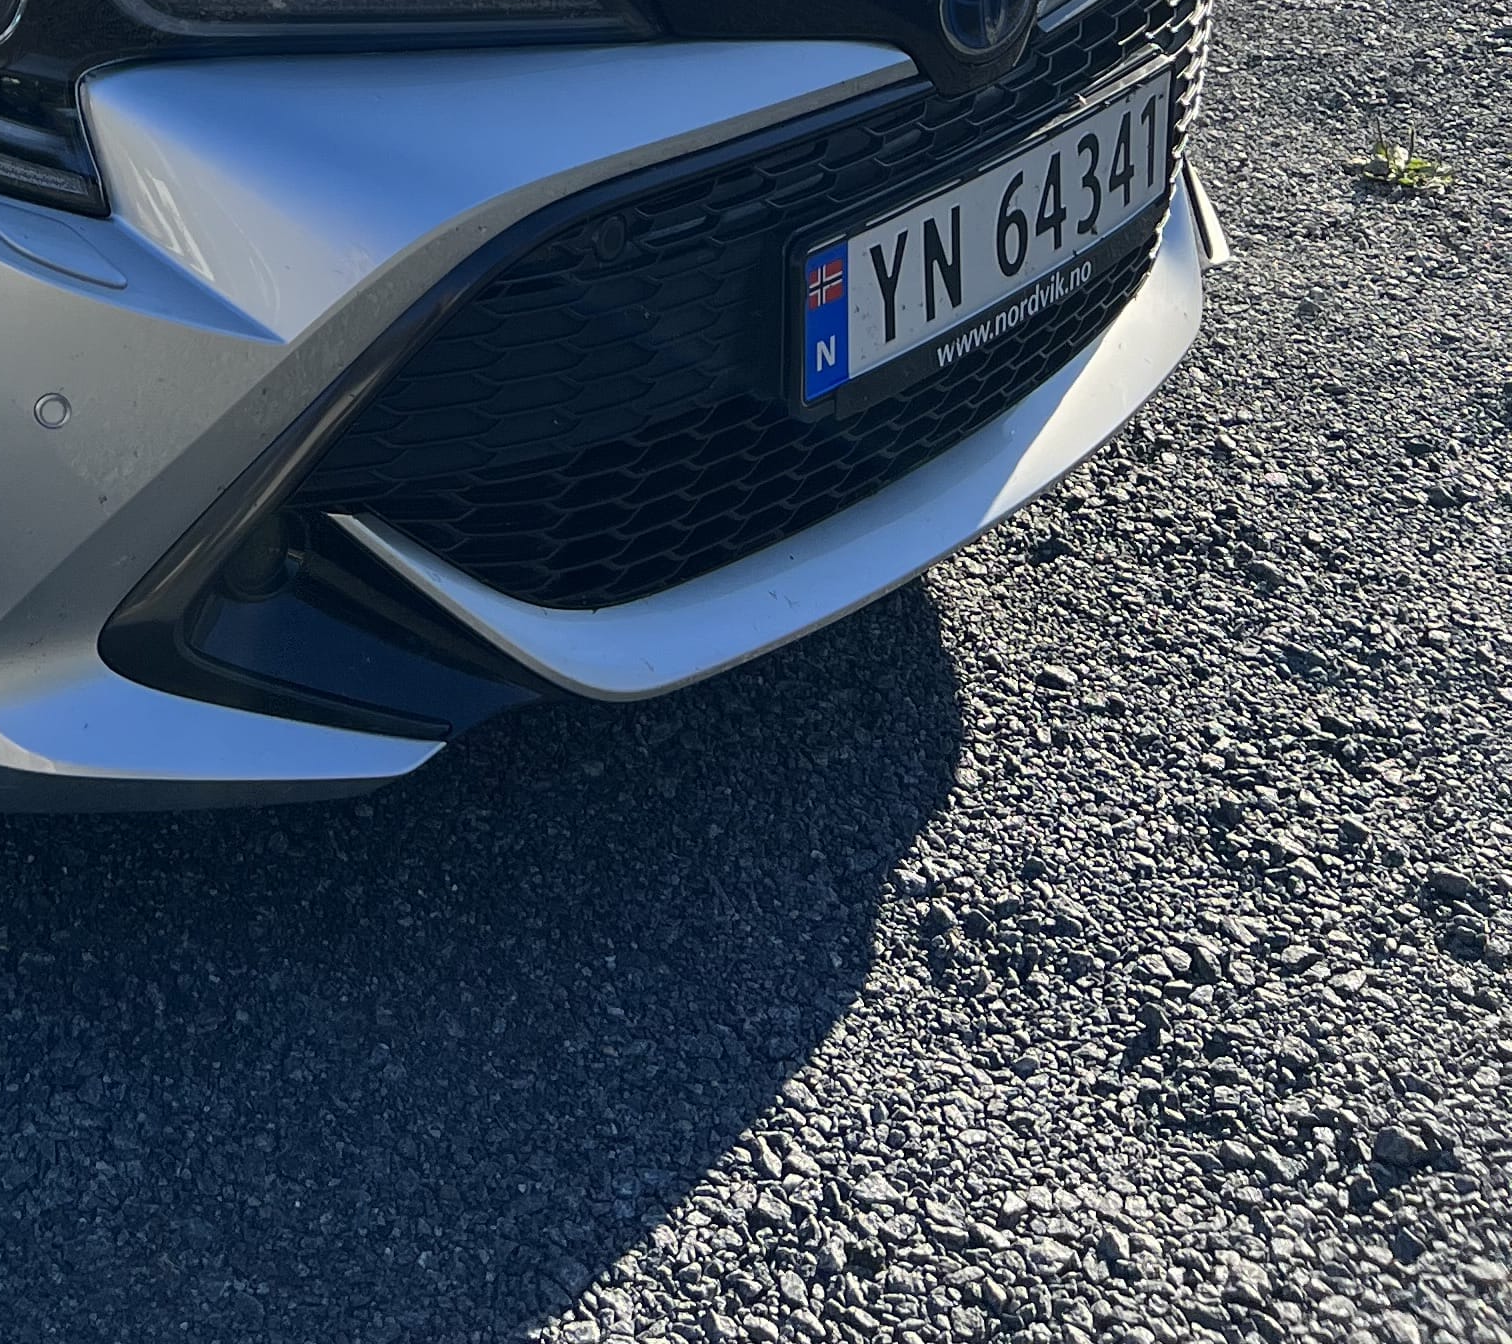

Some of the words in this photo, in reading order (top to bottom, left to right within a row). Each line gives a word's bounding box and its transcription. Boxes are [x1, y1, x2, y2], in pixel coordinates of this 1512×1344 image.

[869, 205, 962, 344] YN
[996, 94, 1156, 279] 64341
[815, 335, 836, 372] N
[937, 260, 1092, 368] www.nordvik.no
